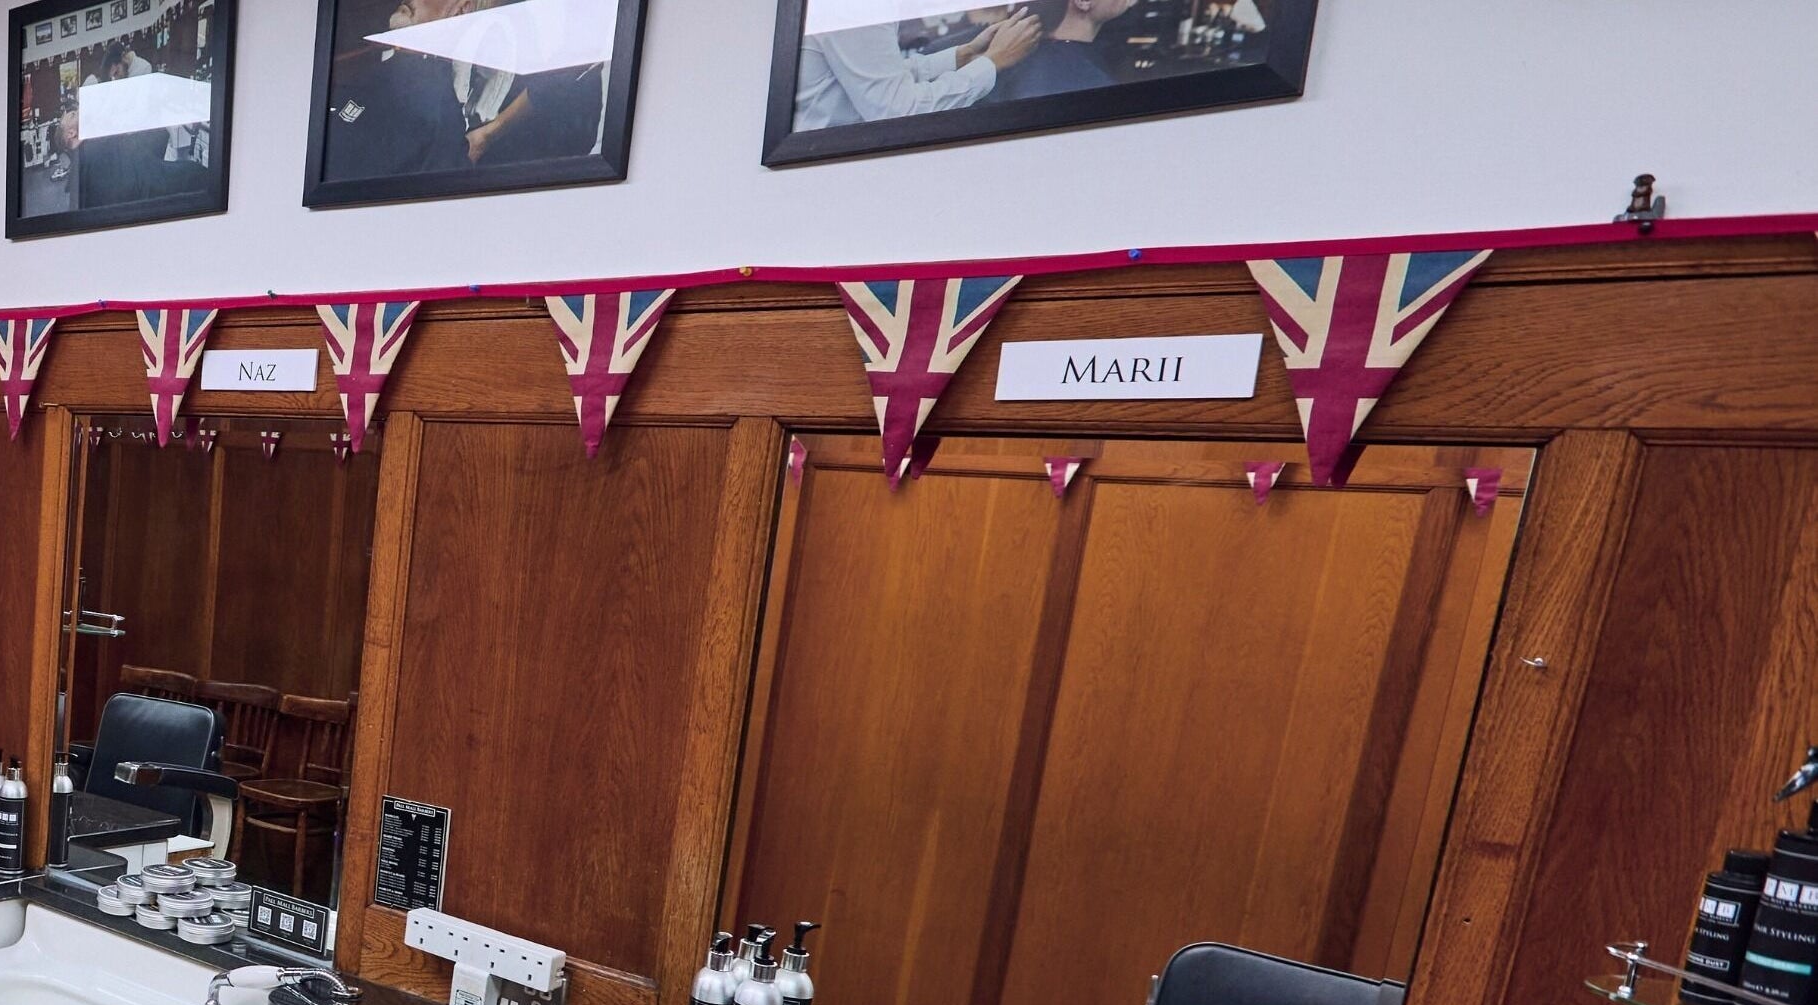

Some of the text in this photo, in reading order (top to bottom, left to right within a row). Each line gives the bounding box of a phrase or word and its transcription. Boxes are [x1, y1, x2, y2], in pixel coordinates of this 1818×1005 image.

[238, 361, 277, 381] NAZ
[1061, 355, 1184, 384] MARII
[1770, 927, 1816, 944] STYLING
